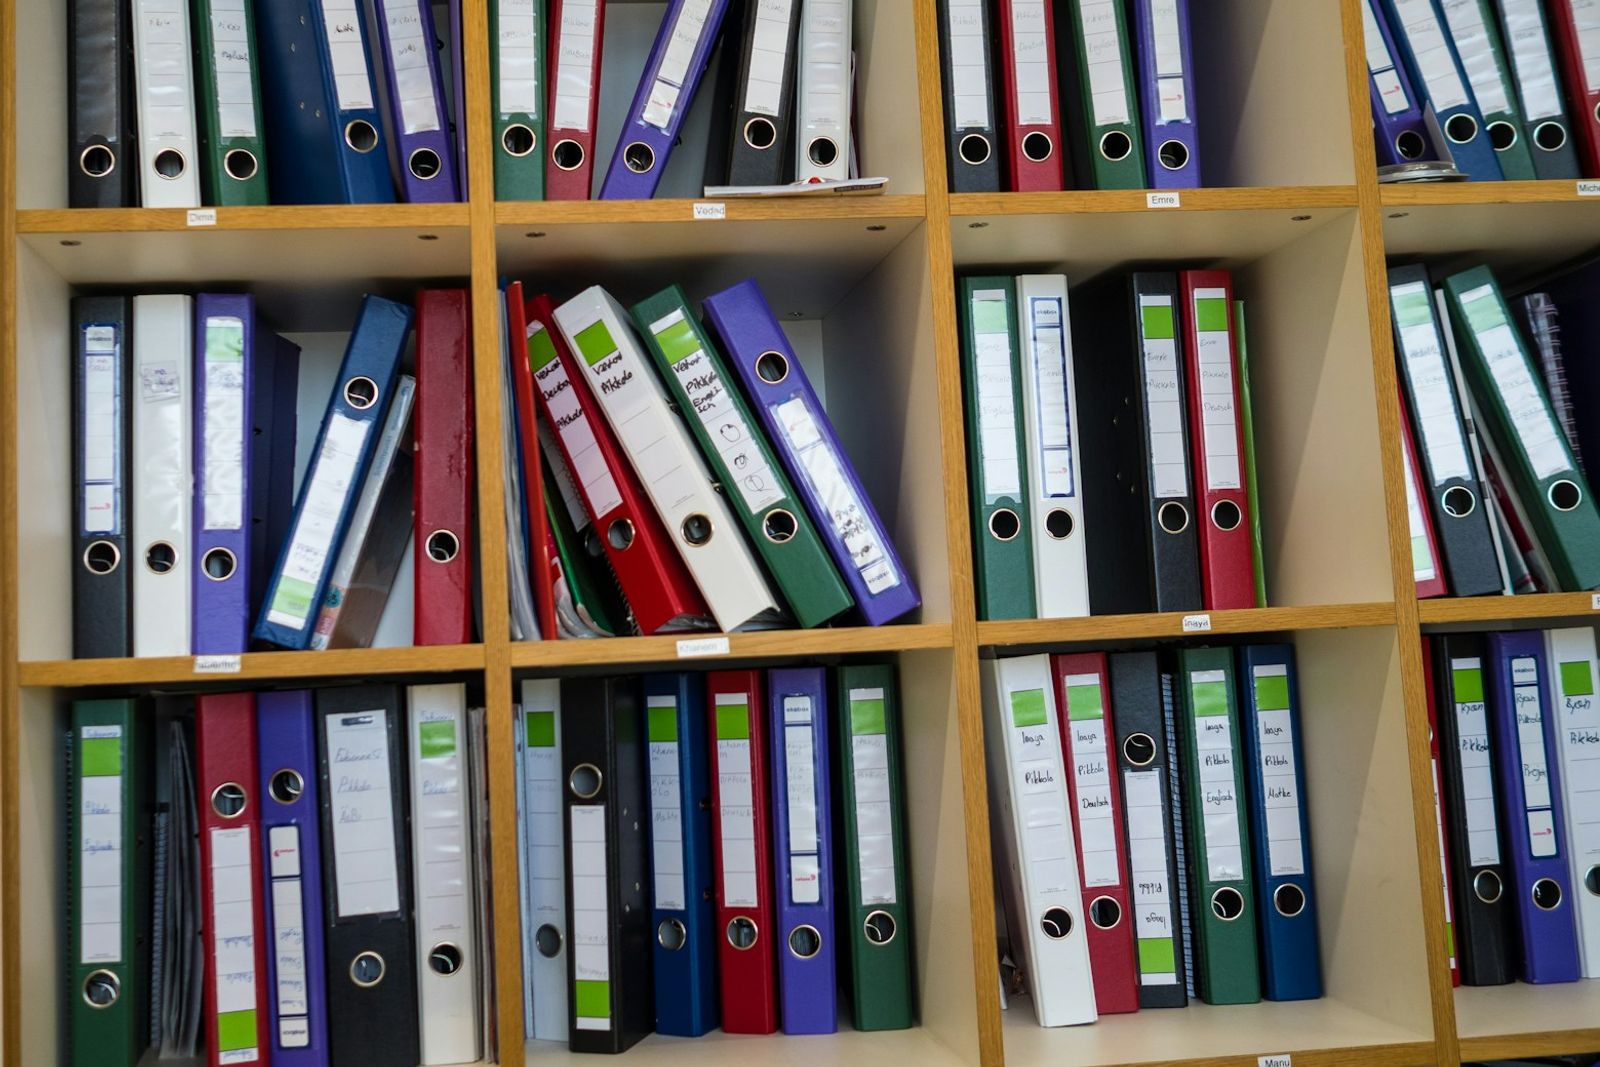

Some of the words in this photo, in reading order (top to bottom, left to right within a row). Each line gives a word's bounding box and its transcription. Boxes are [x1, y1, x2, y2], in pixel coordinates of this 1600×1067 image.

[1152, 195, 1175, 204] Emre
[1516, 693, 1536, 708] Ryan
[1565, 697, 1591, 714] Ryan
[1205, 753, 1230, 767] Pikkolo
[1078, 762, 1105, 776] Pikkolo
[1025, 769, 1054, 784] Pikkolo
[1082, 796, 1109, 809] Deutsch
[1206, 788, 1233, 805] Englisch
[1264, 1059, 1290, 1067] Manu
